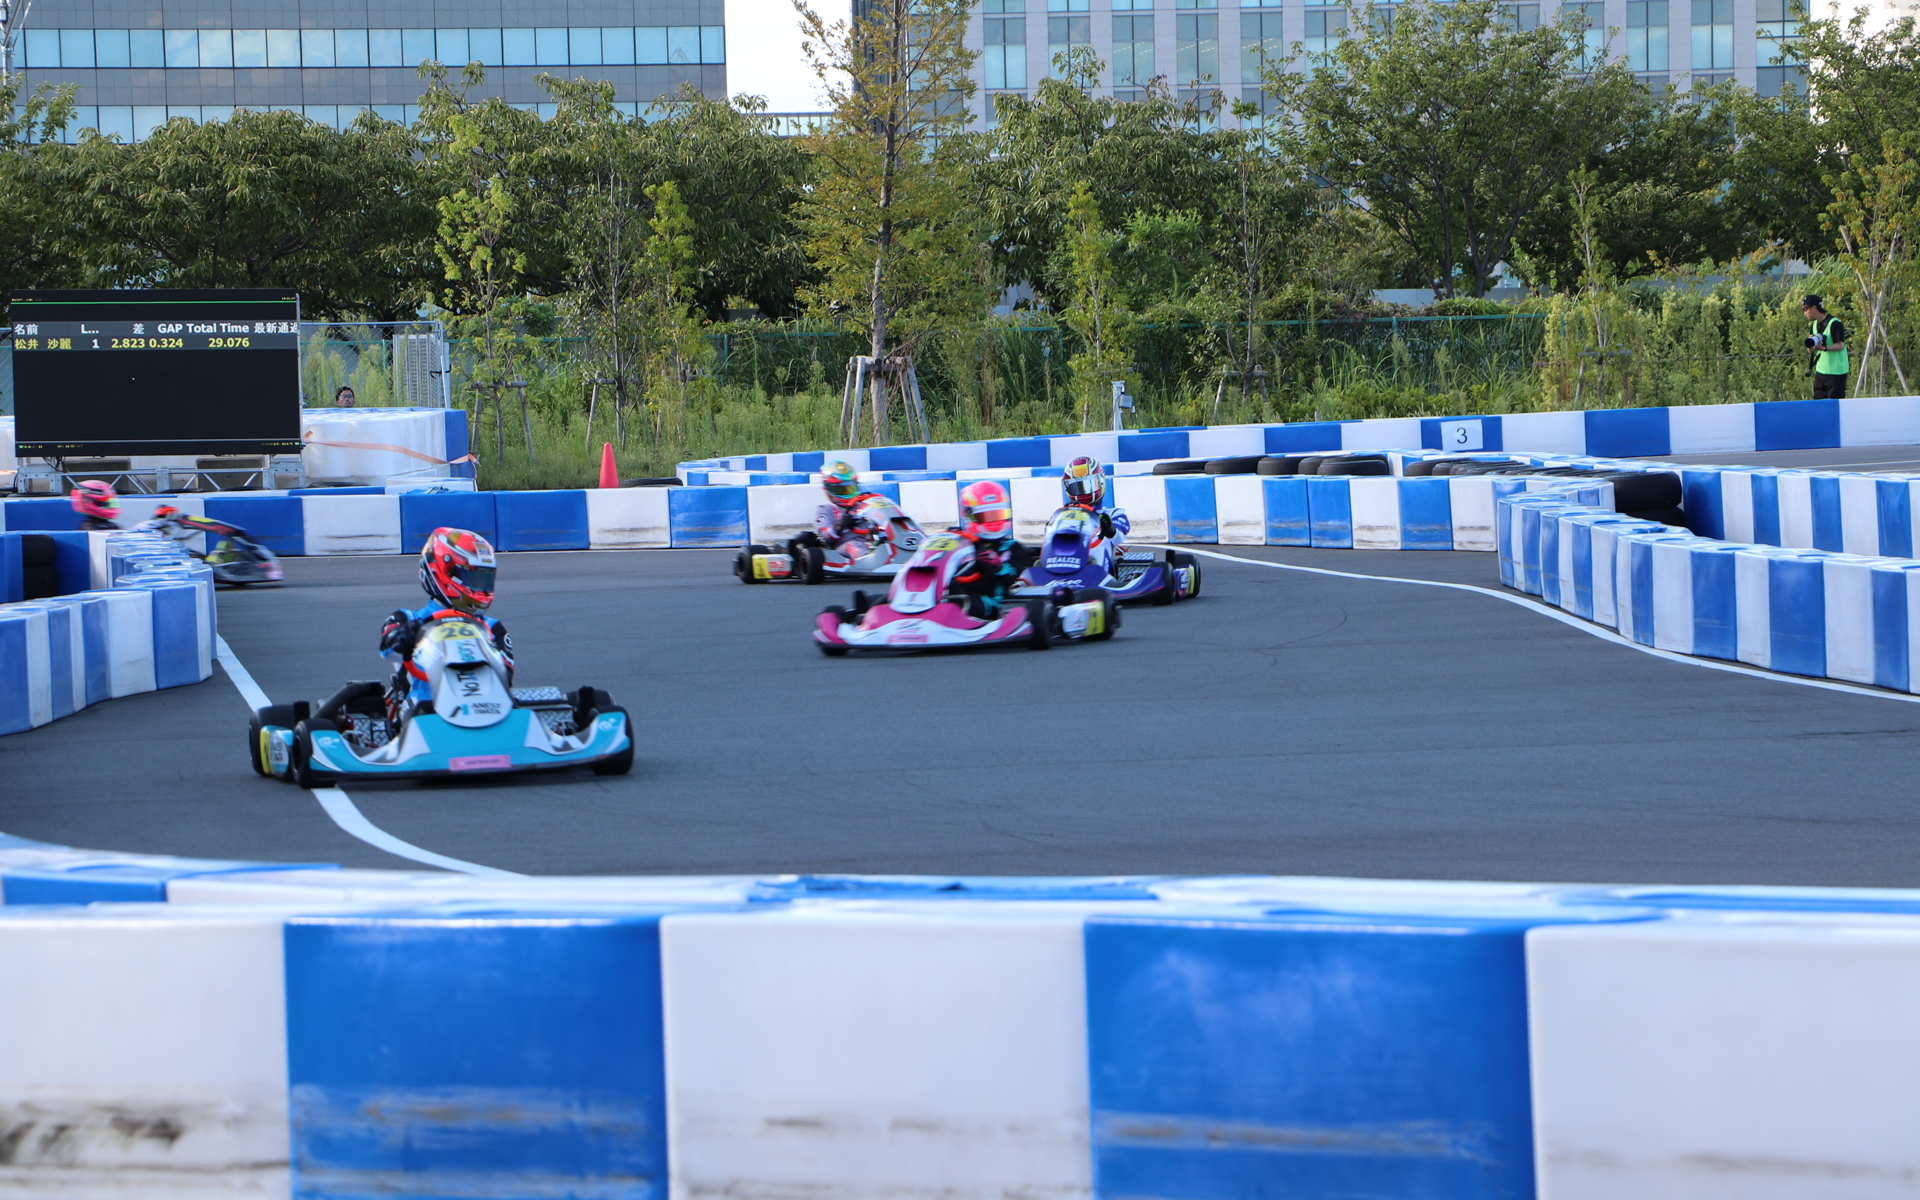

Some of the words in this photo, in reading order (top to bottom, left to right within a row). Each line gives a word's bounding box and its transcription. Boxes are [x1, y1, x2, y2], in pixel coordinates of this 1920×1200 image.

[14, 323, 39, 336] 名前
[132, 322, 145, 335] 差
[157, 322, 184, 334] GAP
[186, 322, 217, 334] Total
[219, 322, 250, 334] Time
[14, 338, 39, 350] 松井
[47, 338, 72, 350] 沙麗
[91, 338, 100, 349] 1
[111, 337, 146, 349] 2.823
[148, 337, 184, 349] 0.324
[208, 337, 250, 348] 29.076
[1456, 427, 1468, 445] 3
[1045, 557, 1082, 565] REALIZE
[440, 626, 475, 639] 26
